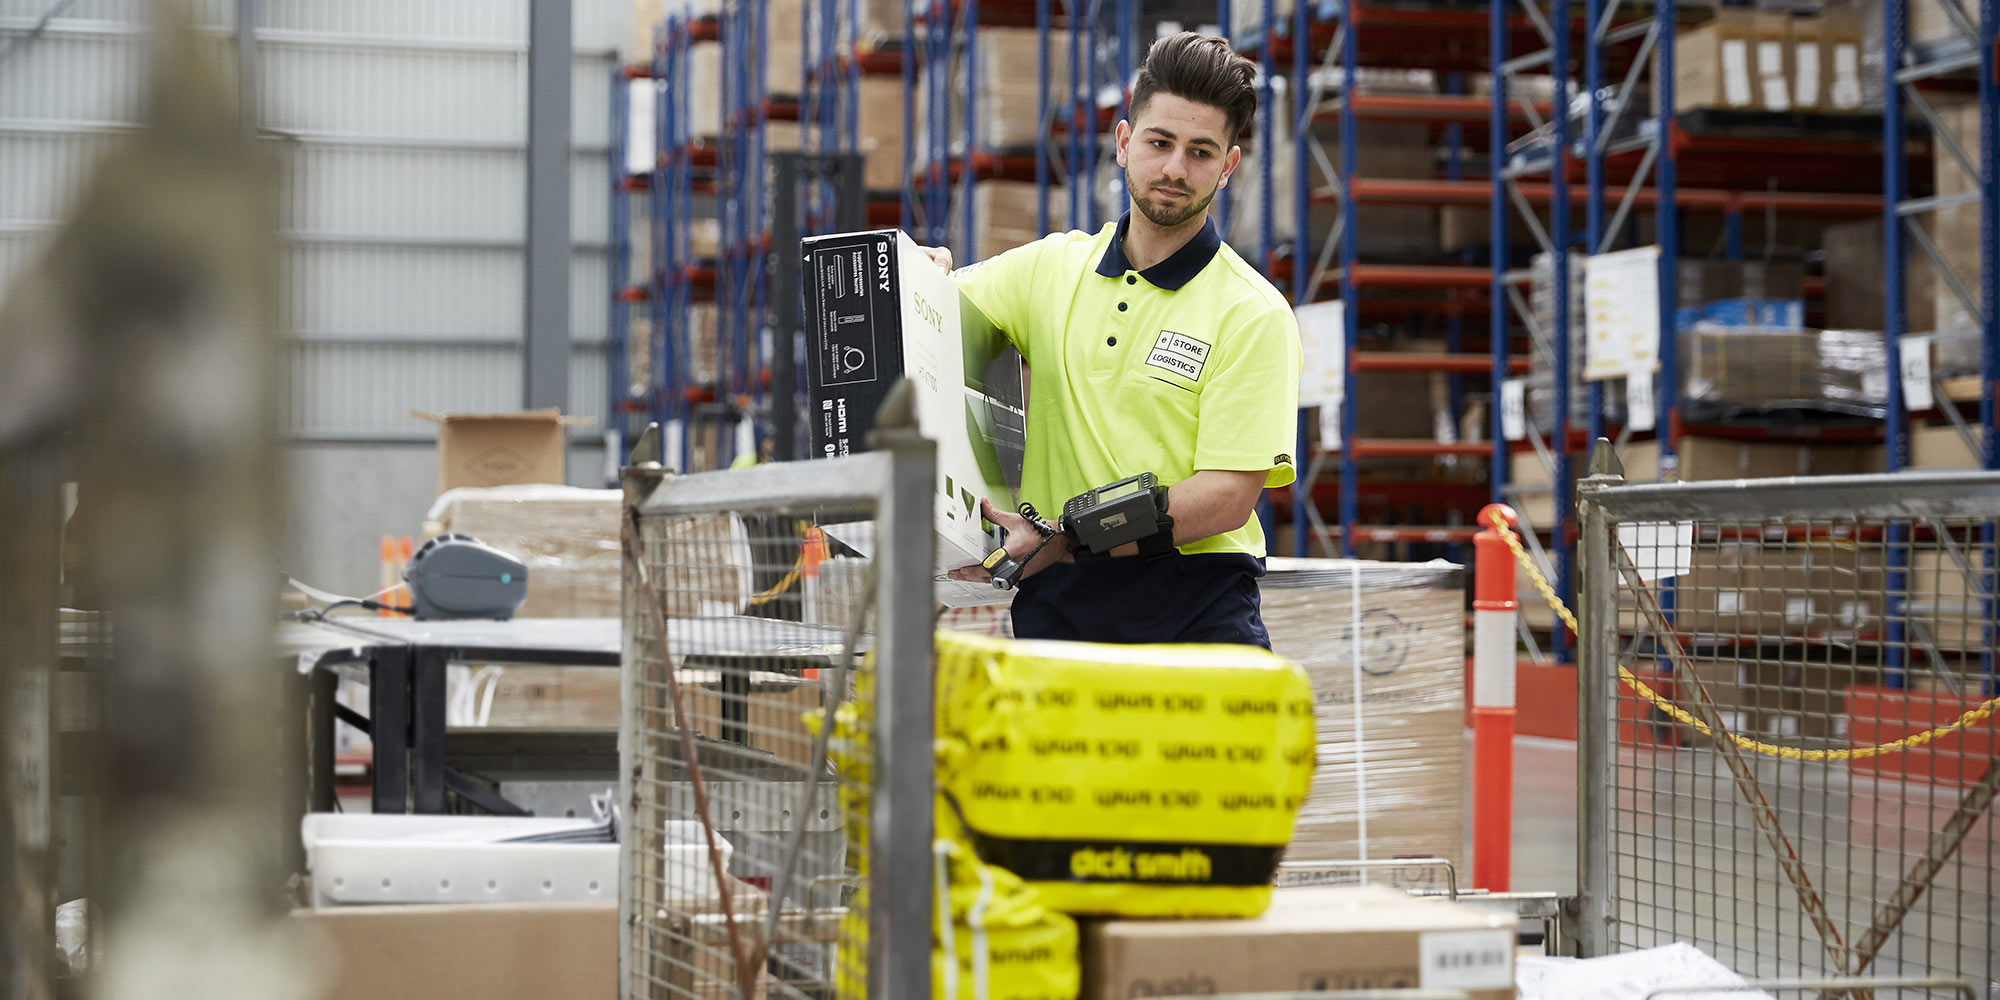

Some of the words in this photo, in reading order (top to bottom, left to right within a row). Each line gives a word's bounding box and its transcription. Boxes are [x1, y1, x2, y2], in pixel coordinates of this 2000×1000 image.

[877, 241, 890, 292] SONY
[914, 291, 942, 333] SONY
[1161, 336, 1168, 344] e
[1173, 339, 1204, 356] STORE
[1153, 353, 1196, 374] LOGISTICS
[837, 398, 847, 433] HDMI
[1070, 847, 1131, 878] dick
[1135, 848, 1212, 880] smith
